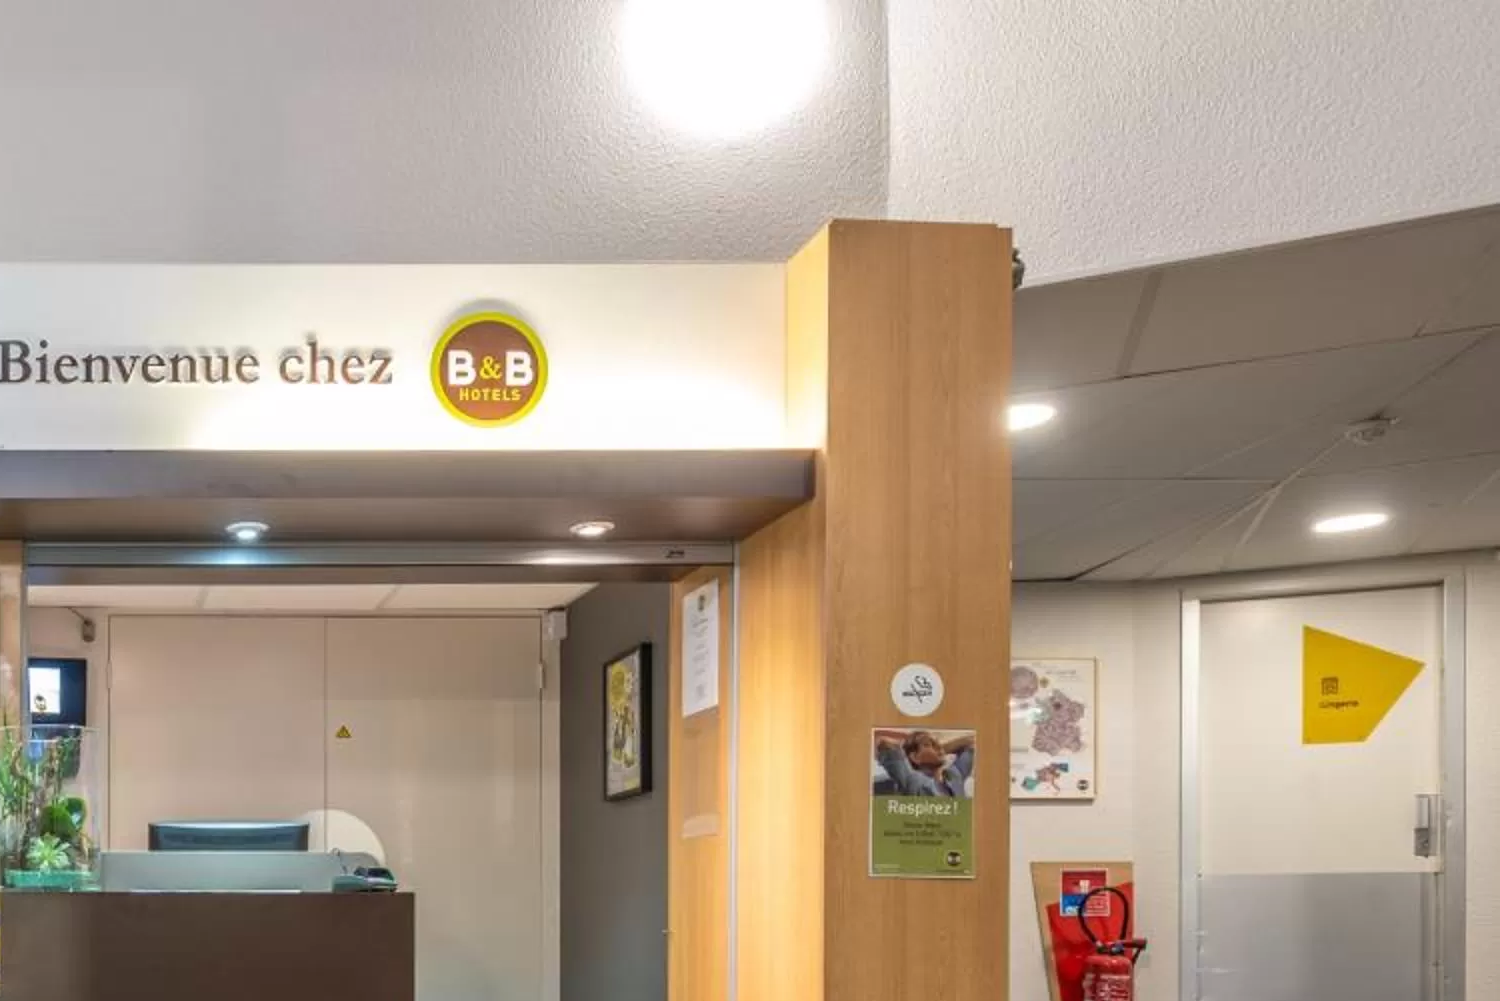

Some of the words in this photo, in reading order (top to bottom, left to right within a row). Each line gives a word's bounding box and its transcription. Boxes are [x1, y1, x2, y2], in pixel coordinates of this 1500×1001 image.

[278, 335, 394, 385] chez
[446, 349, 534, 385] B&B
[458, 387, 522, 402] HOTELS
